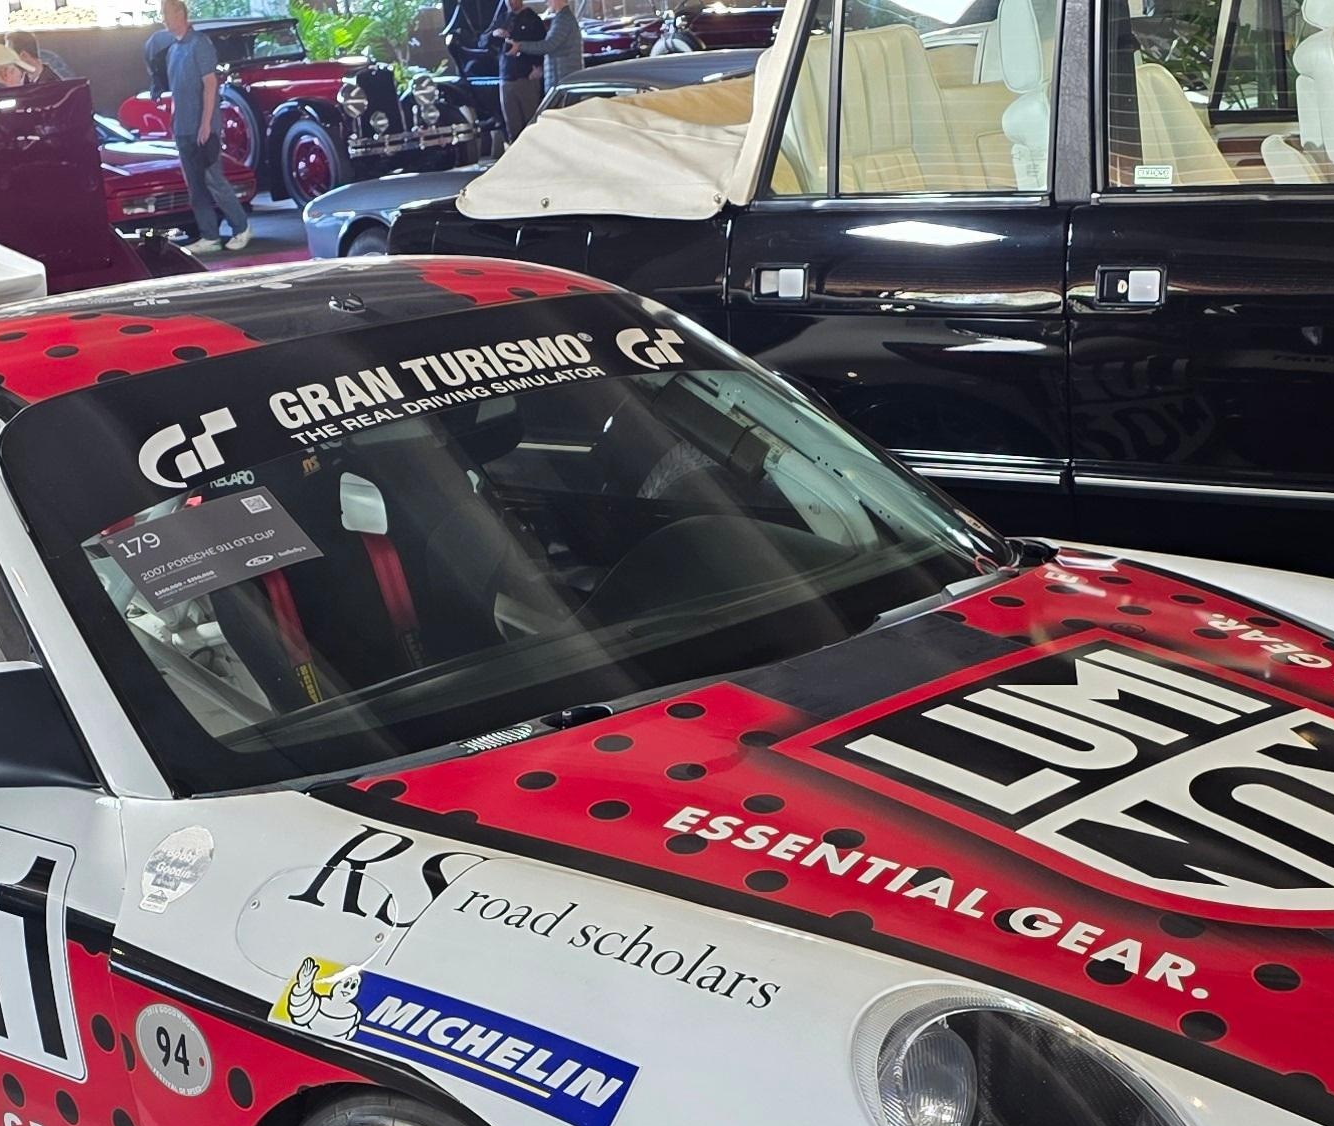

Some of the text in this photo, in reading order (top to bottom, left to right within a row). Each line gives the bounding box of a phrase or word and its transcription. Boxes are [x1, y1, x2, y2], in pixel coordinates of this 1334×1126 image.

[269, 367, 405, 429] GRAN
[291, 364, 607, 446] THE REAL DRIVING SIMULATOR
[118, 532, 161, 558] 179
[140, 565, 166, 581] 2007
[167, 547, 217, 571] PORSCHE
[217, 542, 234, 554] 911
[233, 536, 255, 548] GT3
[254, 528, 276, 542] CUP
[1205, 611, 1333, 670] GEAR.
[844, 648, 1272, 815] LUMI
[287, 823, 491, 928] RS
[662, 805, 1210, 1000] ESSENTIAL GEAR.
[455, 886, 782, 1010] road scholars
[155, 1025, 190, 1076] 94
[367, 996, 623, 1107] MICHELIN
